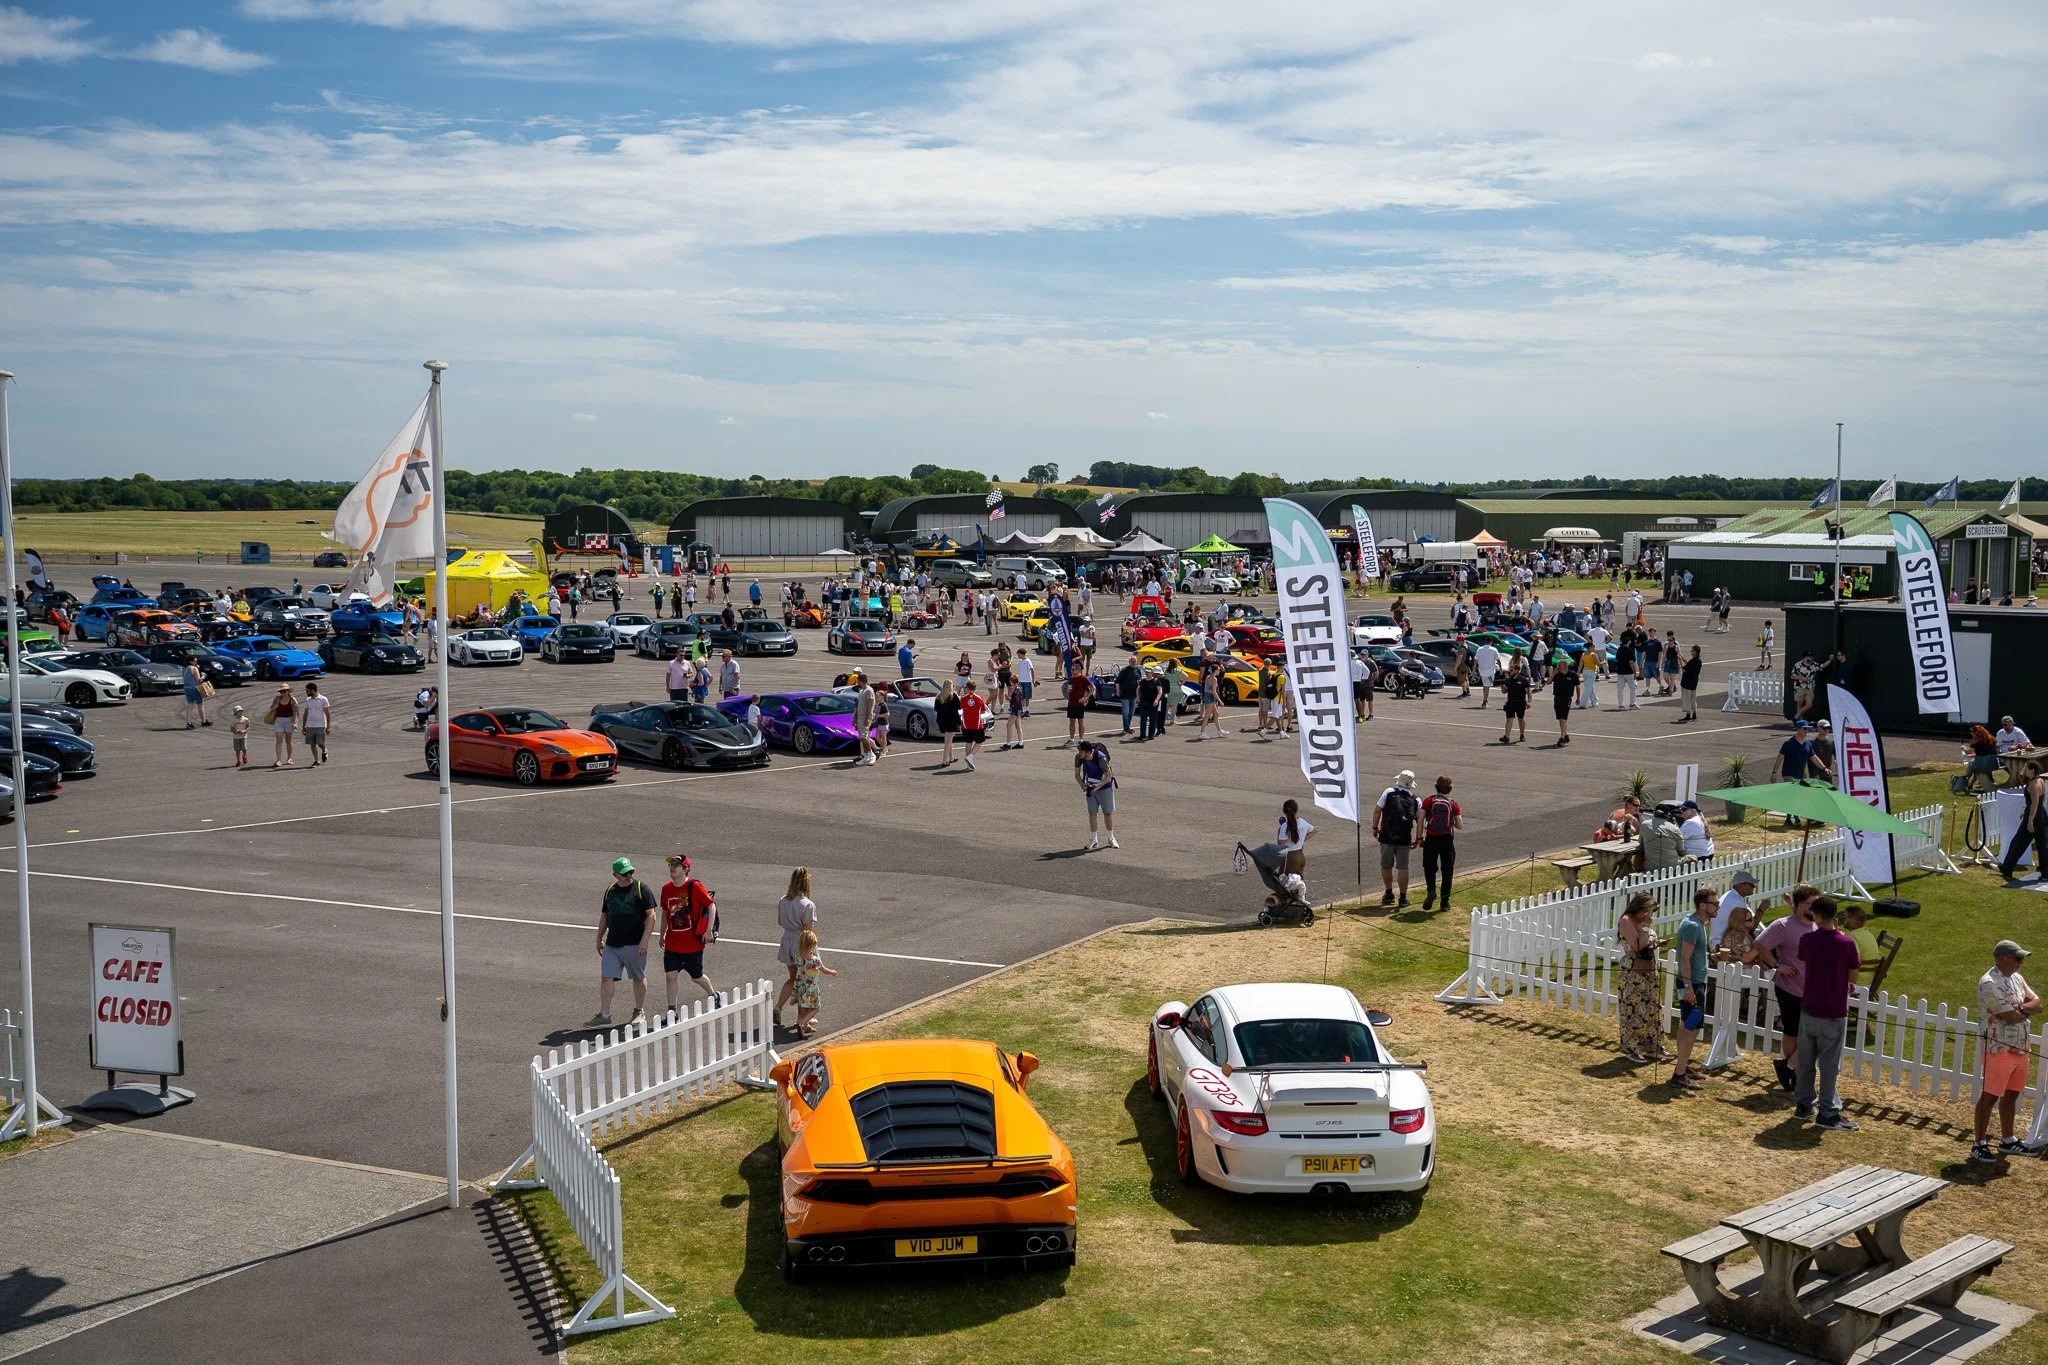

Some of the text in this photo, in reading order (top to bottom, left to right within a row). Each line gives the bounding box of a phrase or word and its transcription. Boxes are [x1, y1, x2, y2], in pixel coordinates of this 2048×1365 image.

[1967, 526, 2007, 536] SCRUTINEERING
[1357, 520, 1377, 573] STEELEFORD
[1055, 620, 1068, 652] COBRA
[1904, 557, 1952, 701] STEELEFORD
[1286, 574, 1346, 799] STEELEFORD
[102, 958, 163, 984] CAFE
[97, 996, 172, 1026] CLOSED
[1304, 1157, 1357, 1171] P911 AFT
[910, 1238, 964, 1252] V10 JUM
